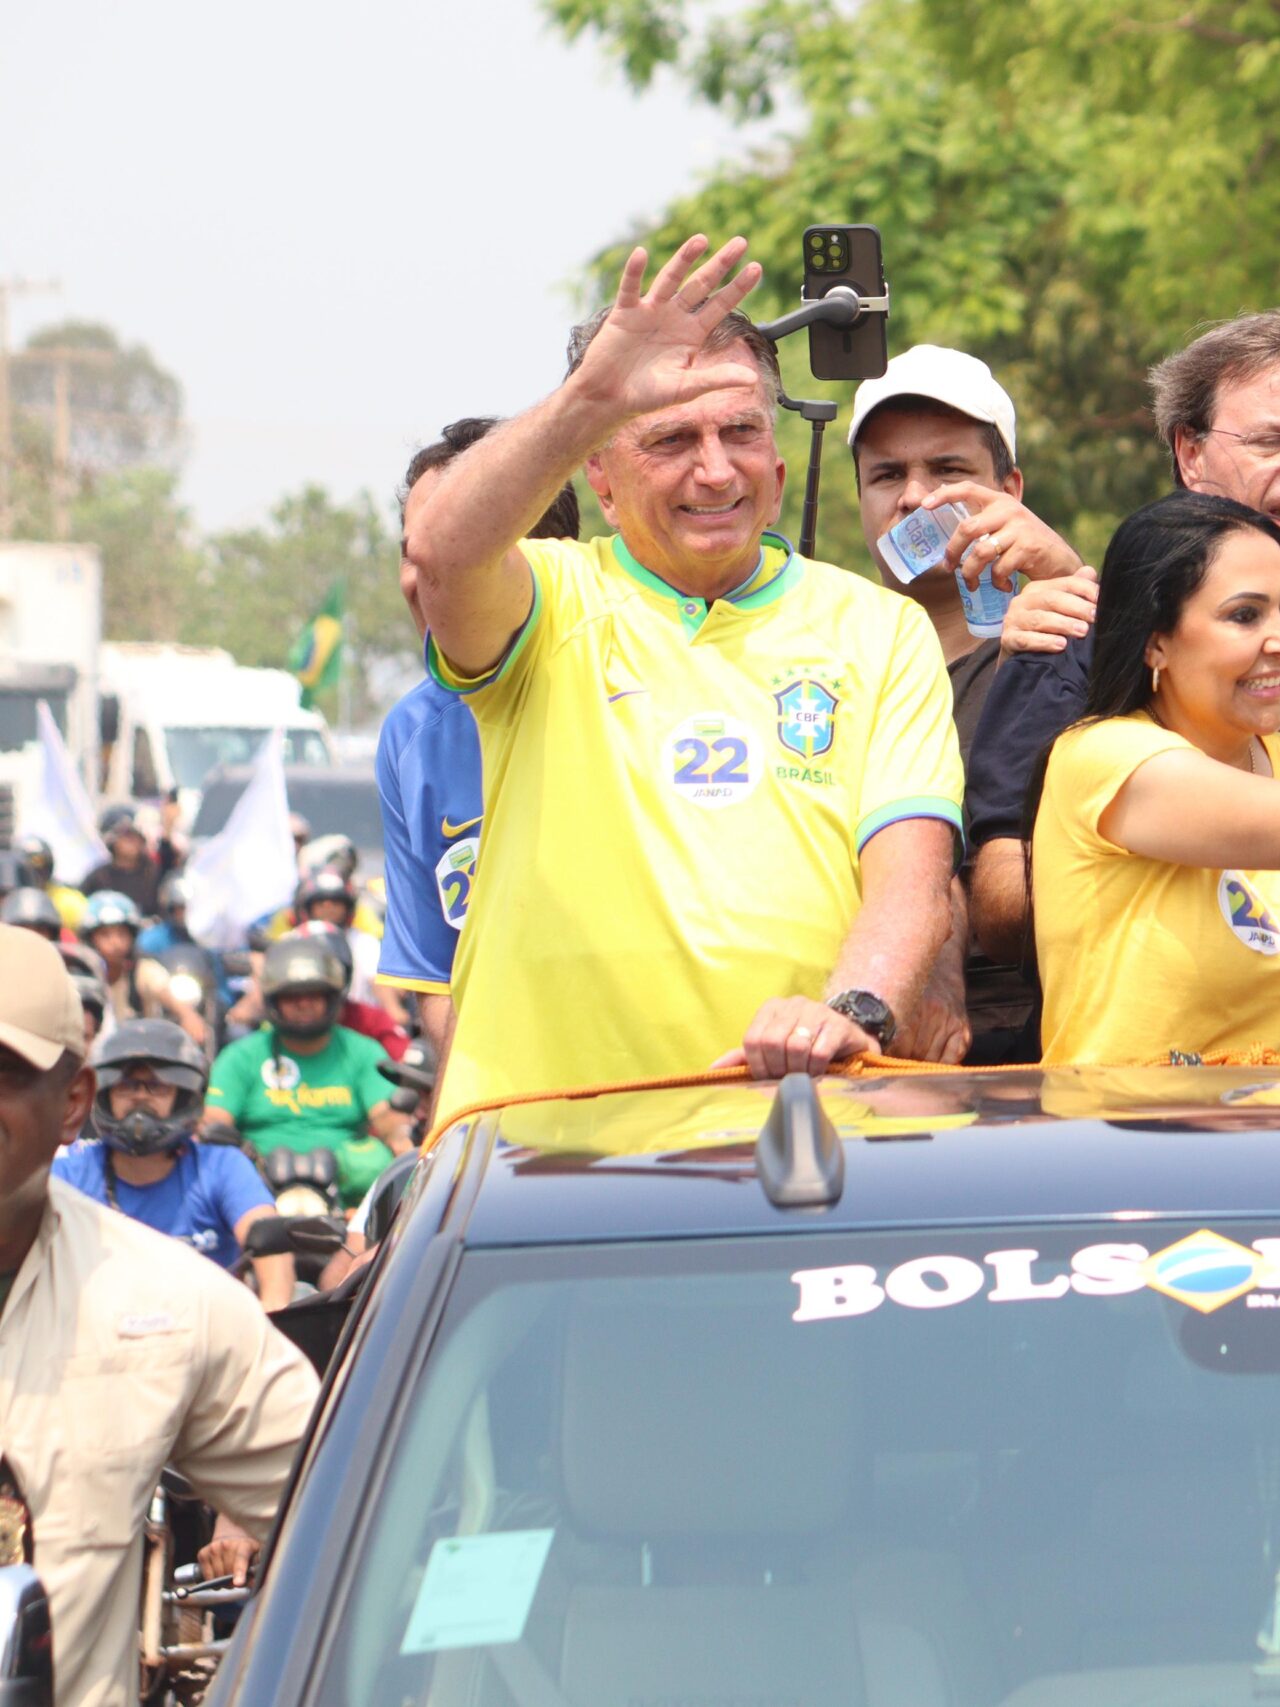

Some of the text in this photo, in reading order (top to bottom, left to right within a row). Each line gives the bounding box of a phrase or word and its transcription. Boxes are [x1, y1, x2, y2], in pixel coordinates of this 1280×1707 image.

[905, 518, 932, 558] Clara
[796, 712, 820, 723] CBF
[673, 736, 750, 784] 22
[776, 766, 835, 786] BRASIL
[441, 860, 477, 921] 2
